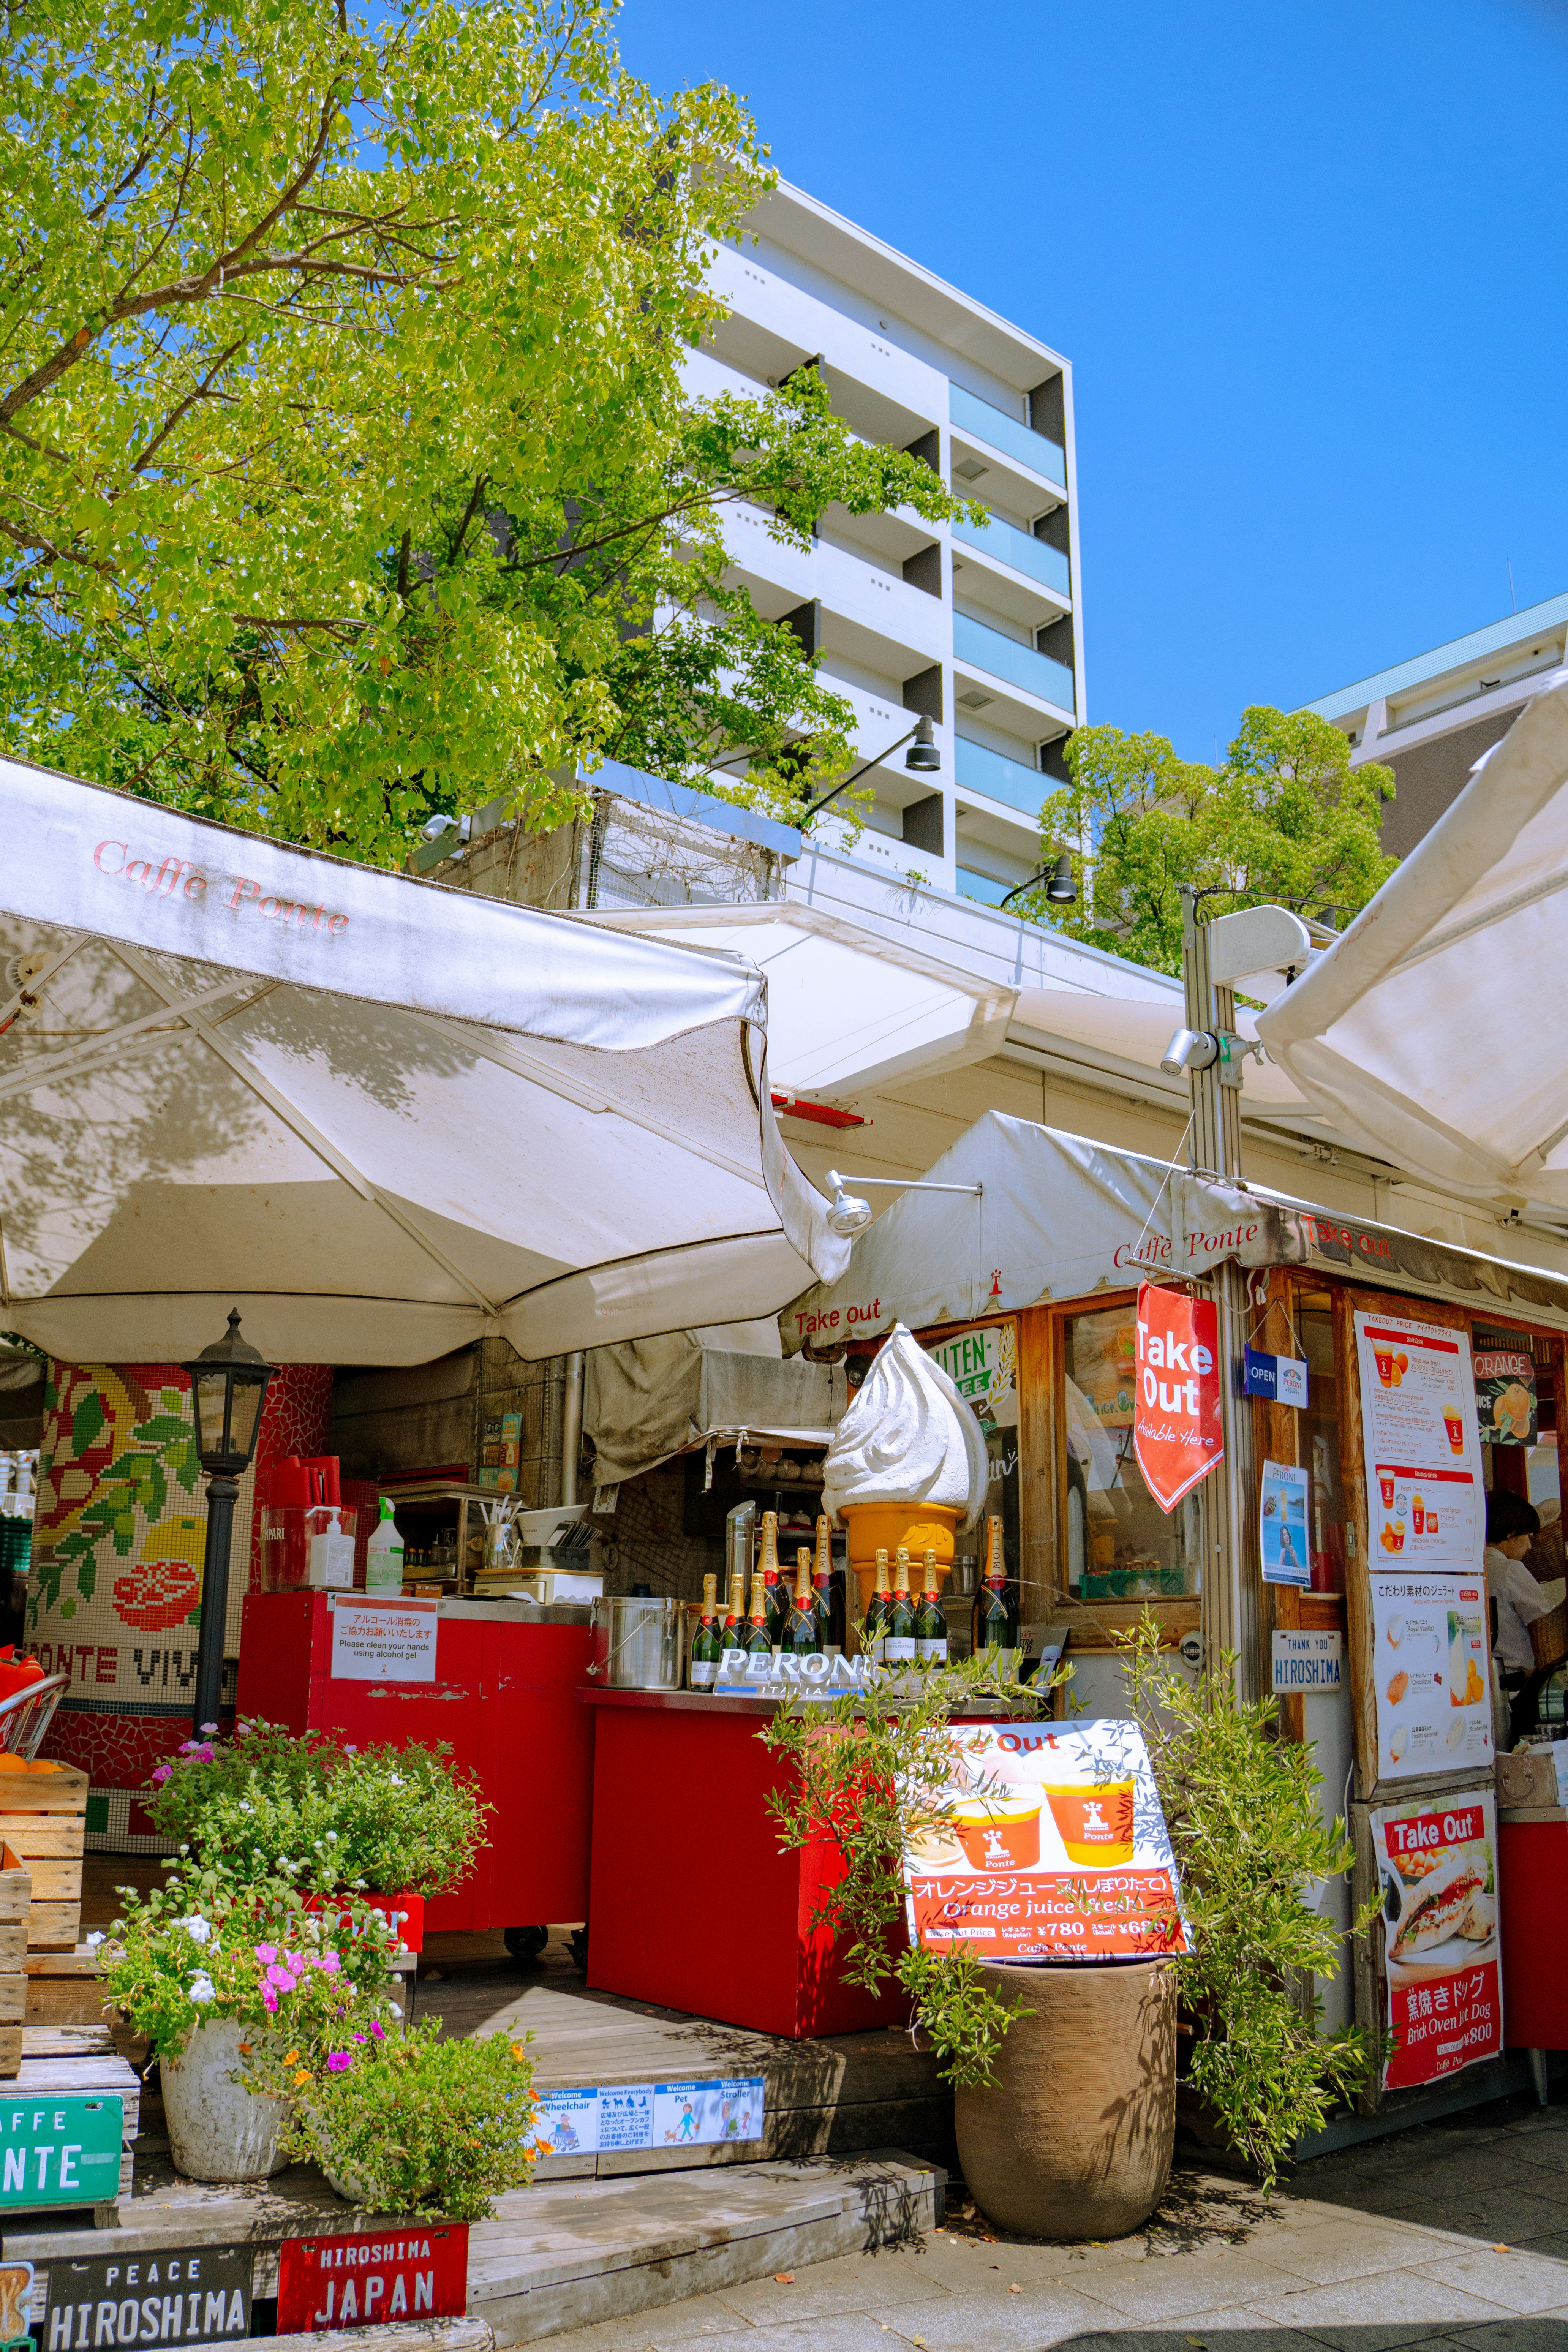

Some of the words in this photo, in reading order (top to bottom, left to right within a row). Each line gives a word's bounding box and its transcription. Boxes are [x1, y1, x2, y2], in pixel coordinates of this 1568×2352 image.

[94, 840, 207, 899] Caffè
[223, 875, 349, 936] Ponte
[1114, 1238, 1172, 1268] Caffè
[1186, 1222, 1258, 1258] Ponte
[1302, 1215, 1352, 1250] Take
[1359, 1235, 1393, 1260] out
[795, 1310, 840, 1335] Take
[847, 1298, 881, 1324] out
[1368, 1315, 1393, 1326] TAKEOUT
[1397, 1320, 1412, 1329] PRICE
[936, 1333, 991, 1378] UTEN-
[1136, 1319, 1213, 1375] Take
[1251, 1367, 1275, 1383] OPEN
[1474, 1355, 1526, 1375] ORANGE
[957, 1376, 985, 1396] EE
[1143, 1367, 1201, 1416] Out
[1283, 1377, 1302, 1389] PERONI
[1137, 1416, 1176, 1442] Available
[1180, 1427, 1215, 1446] Here
[1272, 1468, 1296, 1482] PERONI
[765, 1533, 774, 1565] MOËT
[819, 1536, 827, 1568] MOËT
[991, 1536, 1001, 1569] MOËT
[1378, 1585, 1454, 1597] こだわり素材のジェラート
[353, 1614, 420, 1626] アルコール消毒の
[340, 1626, 432, 1639] ご協力お願いいたします
[1288, 1639, 1310, 1650] THANK
[1315, 1639, 1328, 1650] YOU
[134, 1649, 227, 1688] VIV
[718, 1648, 877, 1682] PERONI
[1275, 1659, 1340, 1684] HIROSHIMA
[762, 1686, 822, 1695] ITALIA
[997, 1733, 1060, 1753] Out
[1394, 1821, 1439, 1850] Take
[1443, 1813, 1472, 1841] Out
[985, 1859, 1015, 1868] Ponte
[943, 1902, 1020, 1919] Orange
[1025, 1899, 1075, 1917] juice
[971, 1928, 993, 1936] Price
[1036, 1922, 1084, 1936] ¥780
[1054, 1942, 1087, 1951] Ponte
[1407, 1971, 1484, 2022] 窯焼きドッグ
[1407, 2022, 1428, 2045] Brick
[1429, 2016, 1457, 2034] Oven
[1471, 2003, 1491, 2020] Dog
[1464, 2023, 1492, 2046] ¥800
[1436, 2058, 1450, 2071] Caffè
[721, 2090, 750, 2099] Stroller
[544, 2101, 590, 2111] Wheelchair
[601, 2109, 650, 2118] 広場及び広場と一体
[0, 2111, 66, 2133] FFE
[600, 2123, 650, 2132] ェについて、広く一般
[601, 2116, 650, 2126] となったオープンカフ
[599, 2138, 646, 2147] お待ち申し上げます。
[600, 2131, 649, 2140] のお客様のご利用を
[320, 2240, 431, 2268] HIROSHIMA
[106, 2259, 201, 2287] PEACE
[315, 2270, 434, 2322] JAPAN
[49, 2288, 245, 2352] HIROSHIMA
